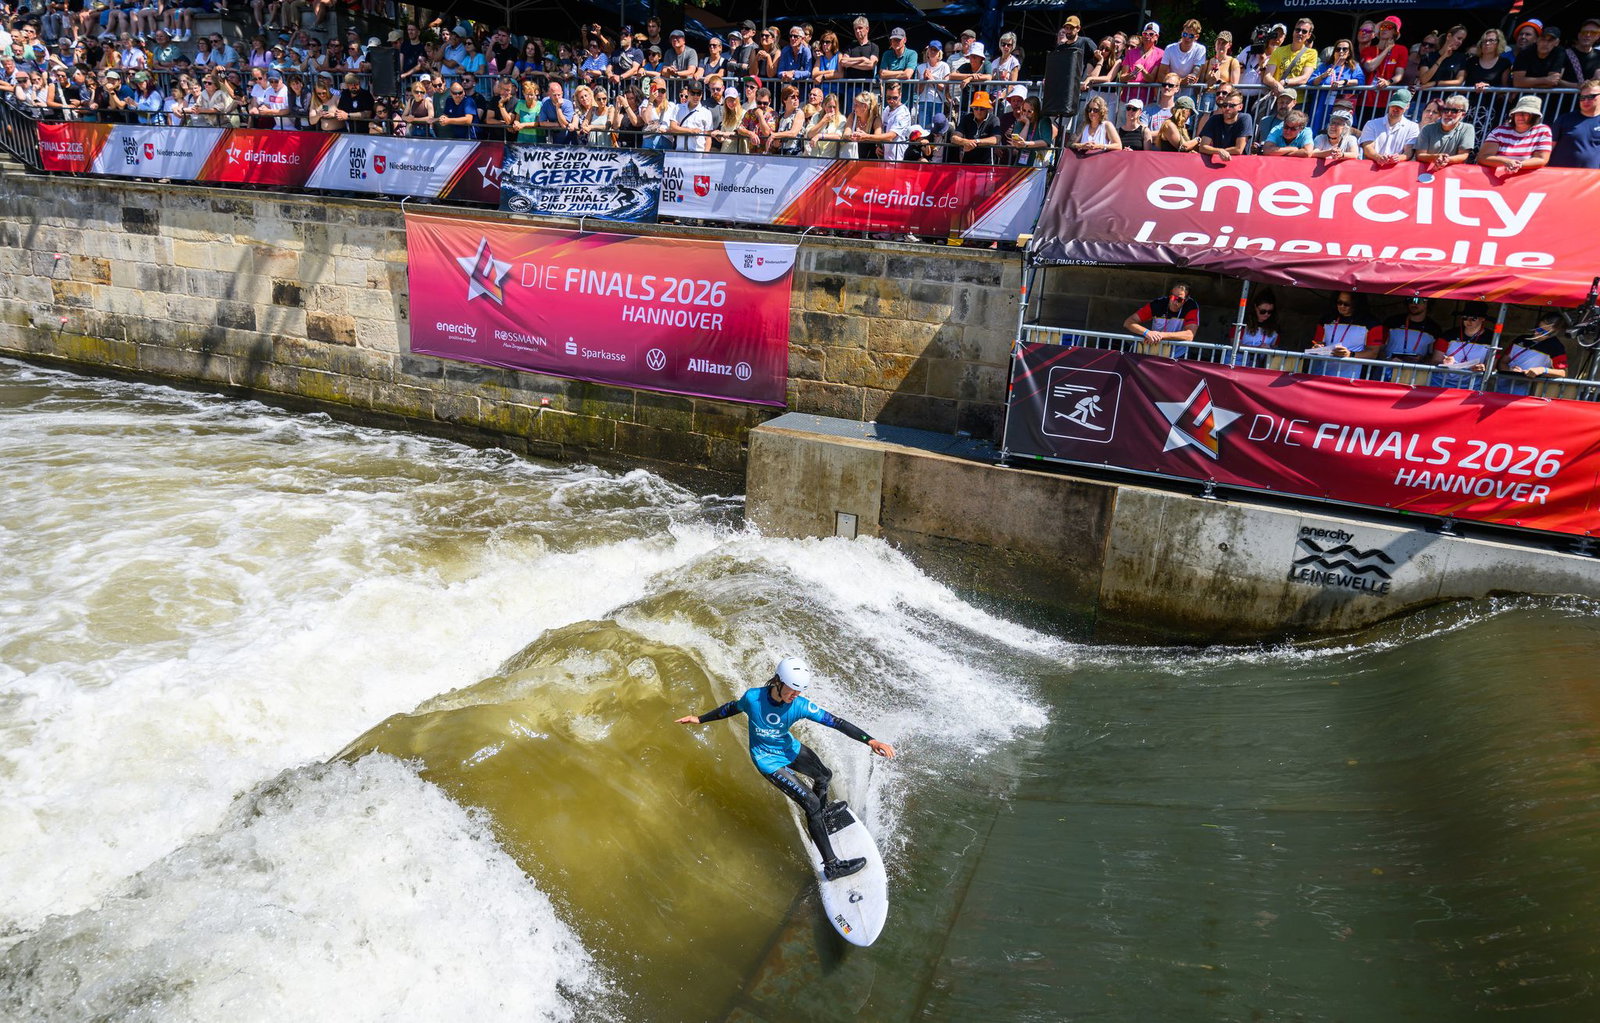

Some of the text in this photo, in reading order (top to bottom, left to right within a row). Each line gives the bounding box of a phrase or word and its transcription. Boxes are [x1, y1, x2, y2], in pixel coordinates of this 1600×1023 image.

[157, 149, 193, 158] Niedersachsen
[244, 150, 301, 165] diefinals.de
[350, 147, 367, 158] HAN
[523, 151, 620, 163] WIR SIND NUR
[389, 161, 435, 173] Niedersachsen
[542, 161, 590, 169] WEGEN
[662, 166, 684, 178] HAN
[530, 165, 618, 185] GERRIT
[560, 186, 593, 195] HIER.
[714, 183, 774, 195] Niedersachsen
[541, 194, 609, 203] DIE FINALS
[862, 188, 959, 208] diefinals.de
[1147, 173, 1547, 237] enercity
[539, 202, 566, 211] SIND
[567, 203, 614, 211] ZUFALL.
[521, 262, 727, 307] DIE FINALS 2026
[621, 305, 724, 331] HANNOVER
[436, 322, 477, 337] enercity
[494, 330, 547, 347] ROSSMANN
[581, 347, 626, 362] Sparkasse
[687, 358, 732, 376] Allianz
[1248, 413, 1564, 478] DIE FINALS 2026
[1394, 467, 1551, 505] HANNOVER
[1301, 526, 1355, 543] enercity
[1287, 564, 1391, 595] LEINEWELLE
